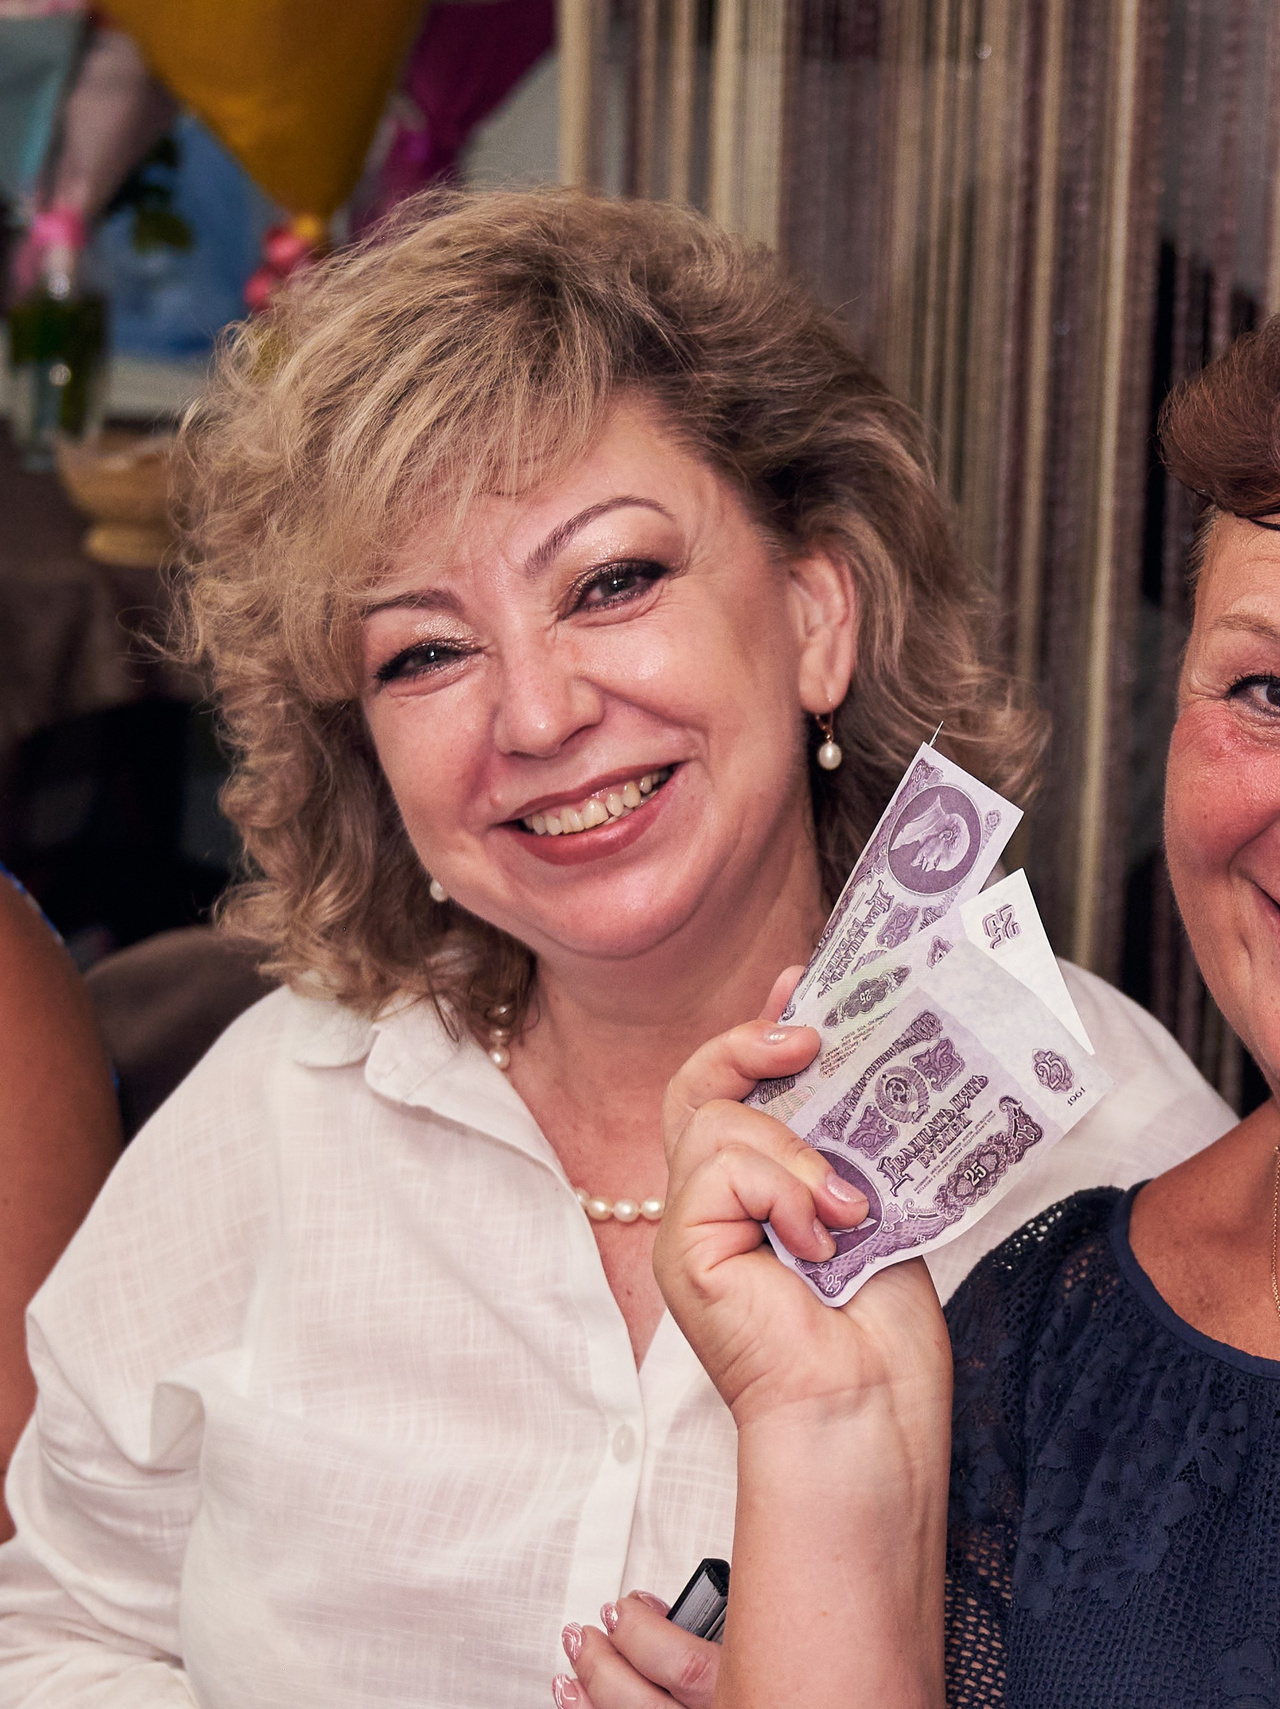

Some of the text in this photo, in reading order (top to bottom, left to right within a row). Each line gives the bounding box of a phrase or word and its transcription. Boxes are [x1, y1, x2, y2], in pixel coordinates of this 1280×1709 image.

[982, 904, 1022, 950] 25
[859, 989, 873, 1005] 25
[1034, 1051, 1067, 1089] 25
[949, 1075, 989, 1112] ПЯТЬ
[1066, 1086, 1086, 1107] 1961
[917, 1112, 973, 1169] РУБЛЕЙ
[963, 1160, 988, 1187] 25
[825, 1273, 842, 1296] 25
